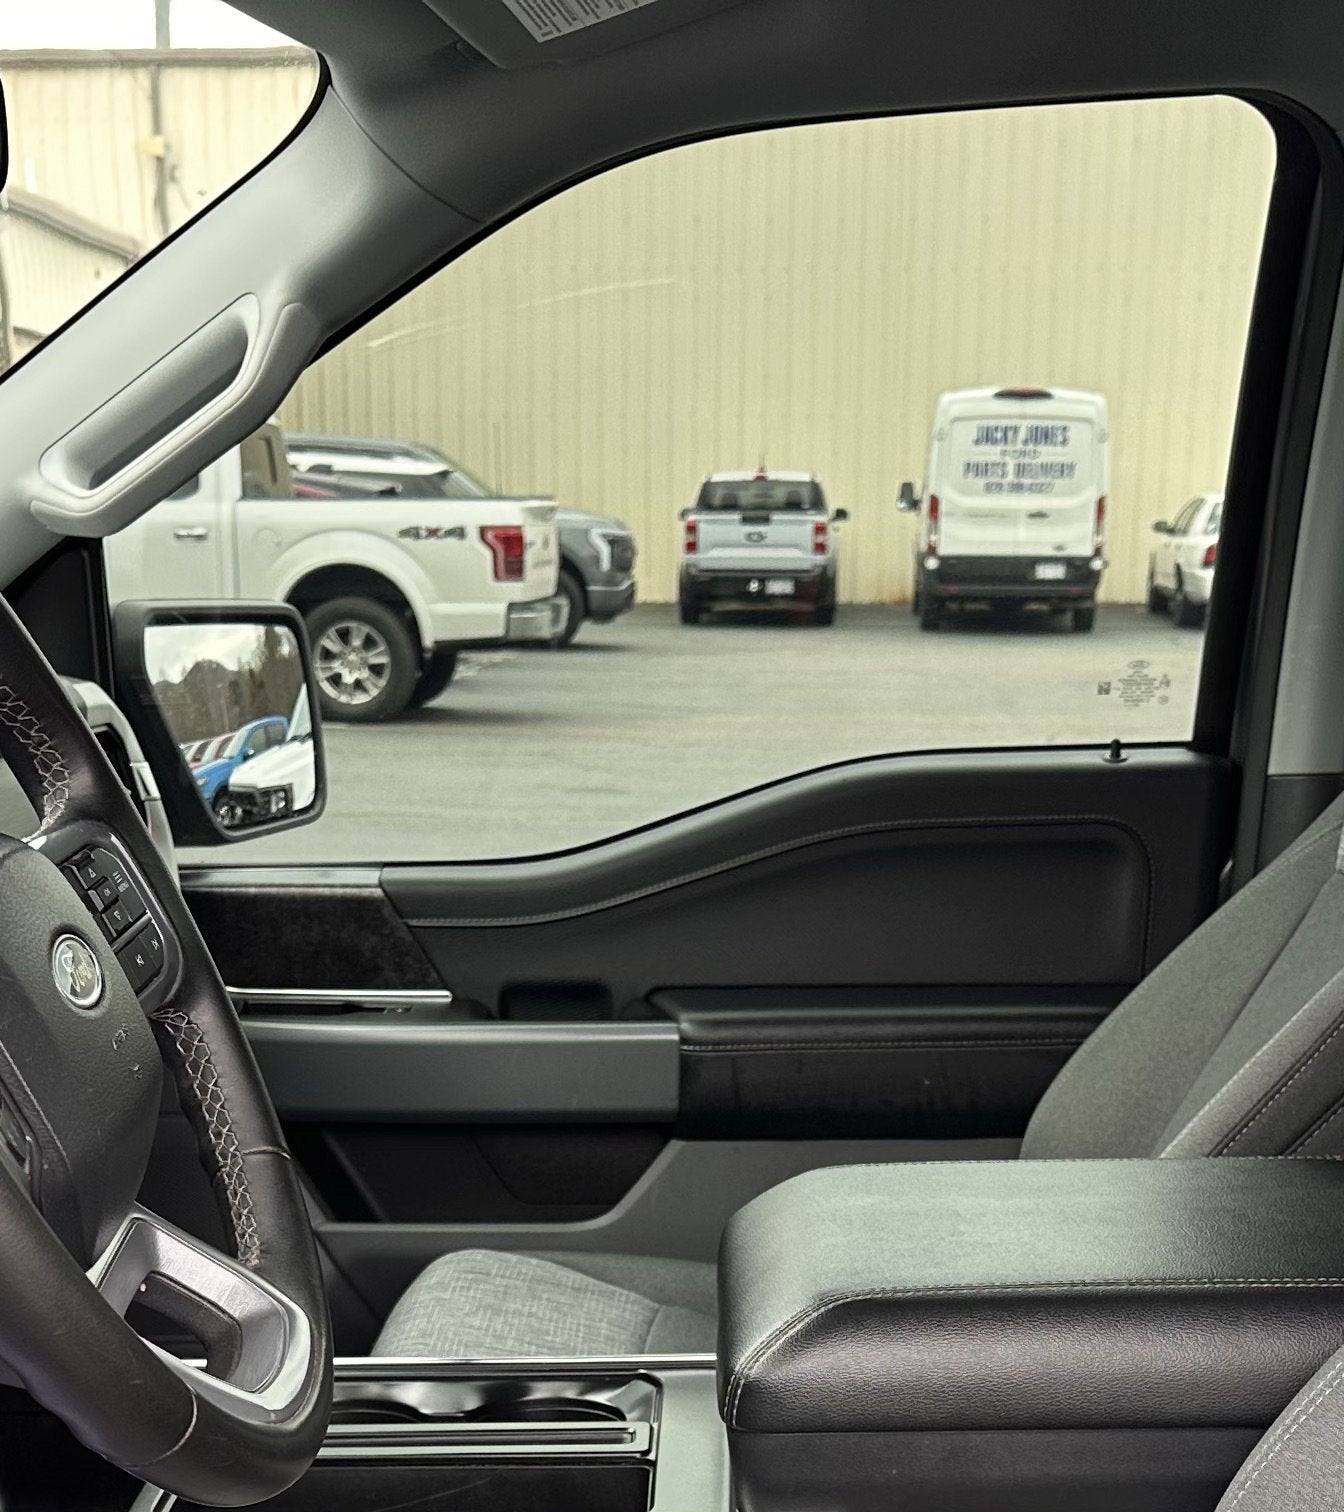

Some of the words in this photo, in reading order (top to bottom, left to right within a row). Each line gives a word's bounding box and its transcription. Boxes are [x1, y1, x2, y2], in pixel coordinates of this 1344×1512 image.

[972, 425, 1020, 446] JACKY
[1022, 425, 1070, 446] JONES
[962, 462, 1009, 479] PARTS
[1013, 462, 1077, 480] DELIVERY
